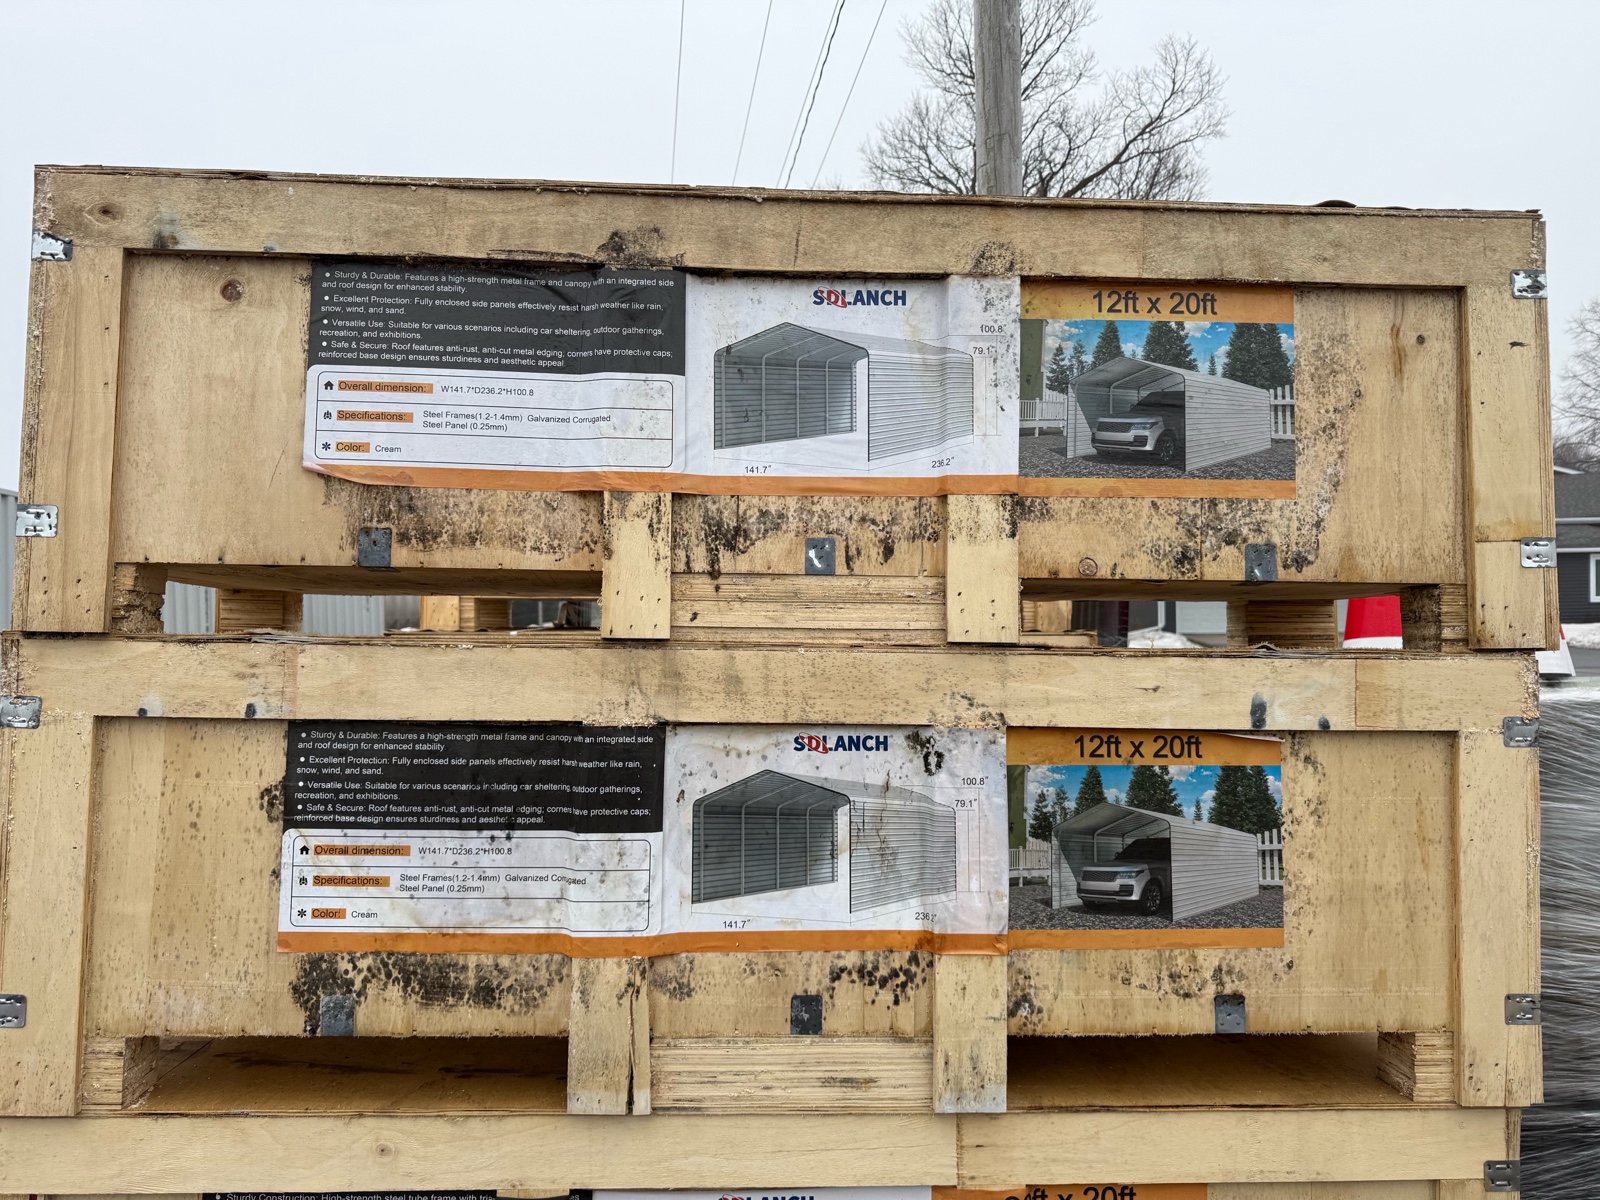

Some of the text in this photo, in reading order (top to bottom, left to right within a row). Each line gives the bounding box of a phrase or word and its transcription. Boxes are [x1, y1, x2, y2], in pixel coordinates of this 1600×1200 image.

[334, 270, 360, 280] Sturdy
[370, 272, 402, 280] Durable:
[405, 273, 439, 282] Features
[448, 275, 499, 284] high-strength
[524, 278, 546, 286] frame
[564, 280, 592, 289] canopy
[618, 277, 656, 288] integrated
[658, 279, 674, 287] side
[338, 281, 468, 294] roof design enhanced stability.
[333, 295, 369, 303] Excellent
[371, 296, 413, 304] Protection:
[414, 298, 432, 307] Fully
[434, 299, 470, 307] enclosed
[471, 300, 488, 308] side
[490, 301, 516, 309] panels
[517, 302, 556, 312] effectively
[600, 302, 630, 310] weather
[631, 302, 645, 310] like
[646, 303, 664, 311] rain,
[1093, 290, 1217, 315] 12ft x 20ft
[385, 307, 406, 315] sand.
[331, 319, 366, 327] Versatile
[367, 320, 386, 328] Use:
[388, 321, 420, 329] Suitable
[464, 324, 502, 332] scenarios
[504, 325, 538, 335] including
[554, 328, 592, 337] sheltering,
[622, 326, 664, 336] gatherings,
[319, 330, 423, 340] recreation, exhibitions.
[331, 341, 349, 349] Safe
[359, 341, 389, 350] Secure:
[391, 342, 411, 350] Roof
[412, 343, 444, 351] features
[446, 345, 480, 354] anti-rust,
[482, 346, 511, 355] anti-cut
[536, 348, 565, 358] edging;
[567, 350, 593, 358] corners
[613, 349, 651, 357] protective
[652, 350, 673, 358] caps;
[318, 351, 357, 359] reinforced
[359, 352, 378, 360] base
[380, 353, 407, 362] design
[441, 355, 482, 364] sturdiness
[500, 357, 536, 366] aesthetic
[537, 358, 565, 367] appeal.
[338, 381, 373, 391] Overall
[375, 383, 426, 393] dimension:
[337, 410, 406, 422] Specifications:
[423, 410, 444, 419] Steel
[527, 415, 570, 424] Galvanized
[572, 415, 611, 425] Corrugated
[422, 420, 508, 432] Steel Panel (0.25mm)
[336, 442, 402, 453] Color: Cream
[310, 731, 336, 740] Sturdy
[347, 732, 380, 740] Durable:
[382, 732, 417, 740] Features
[427, 732, 479, 741] high-strength
[504, 733, 527, 741] frame
[545, 734, 573, 743] canopy
[596, 736, 635, 745] integrated
[332, 742, 359, 751] design
[373, 742, 413, 750] enhanced
[414, 743, 446, 752] stability.
[1075, 734, 1202, 759] 12ft x 20ft
[309, 756, 642, 769] Excellent Protection: Fully enclosed side panels effectively resist rain,
[296, 767, 384, 775] snow, wind, sand.
[307, 781, 643, 795] Versatile Use: Suitable various gatherings,
[294, 791, 400, 800] recreation, exhibitions.
[306, 804, 628, 817] Safe Secure: Roof features anti-rust, anti-cut metal protective
[293, 814, 333, 822] reinforced
[356, 815, 384, 824] design
[419, 815, 460, 823] sturdiness
[516, 816, 545, 825] appeal.
[314, 845, 349, 855] Overall
[351, 846, 404, 855] dimension:
[313, 875, 383, 886] Specifications:
[400, 874, 420, 882] Steel
[505, 874, 549, 882] Galvanized
[446, 885, 485, 893] (0.25mm)
[312, 909, 378, 919] Color: Cream
